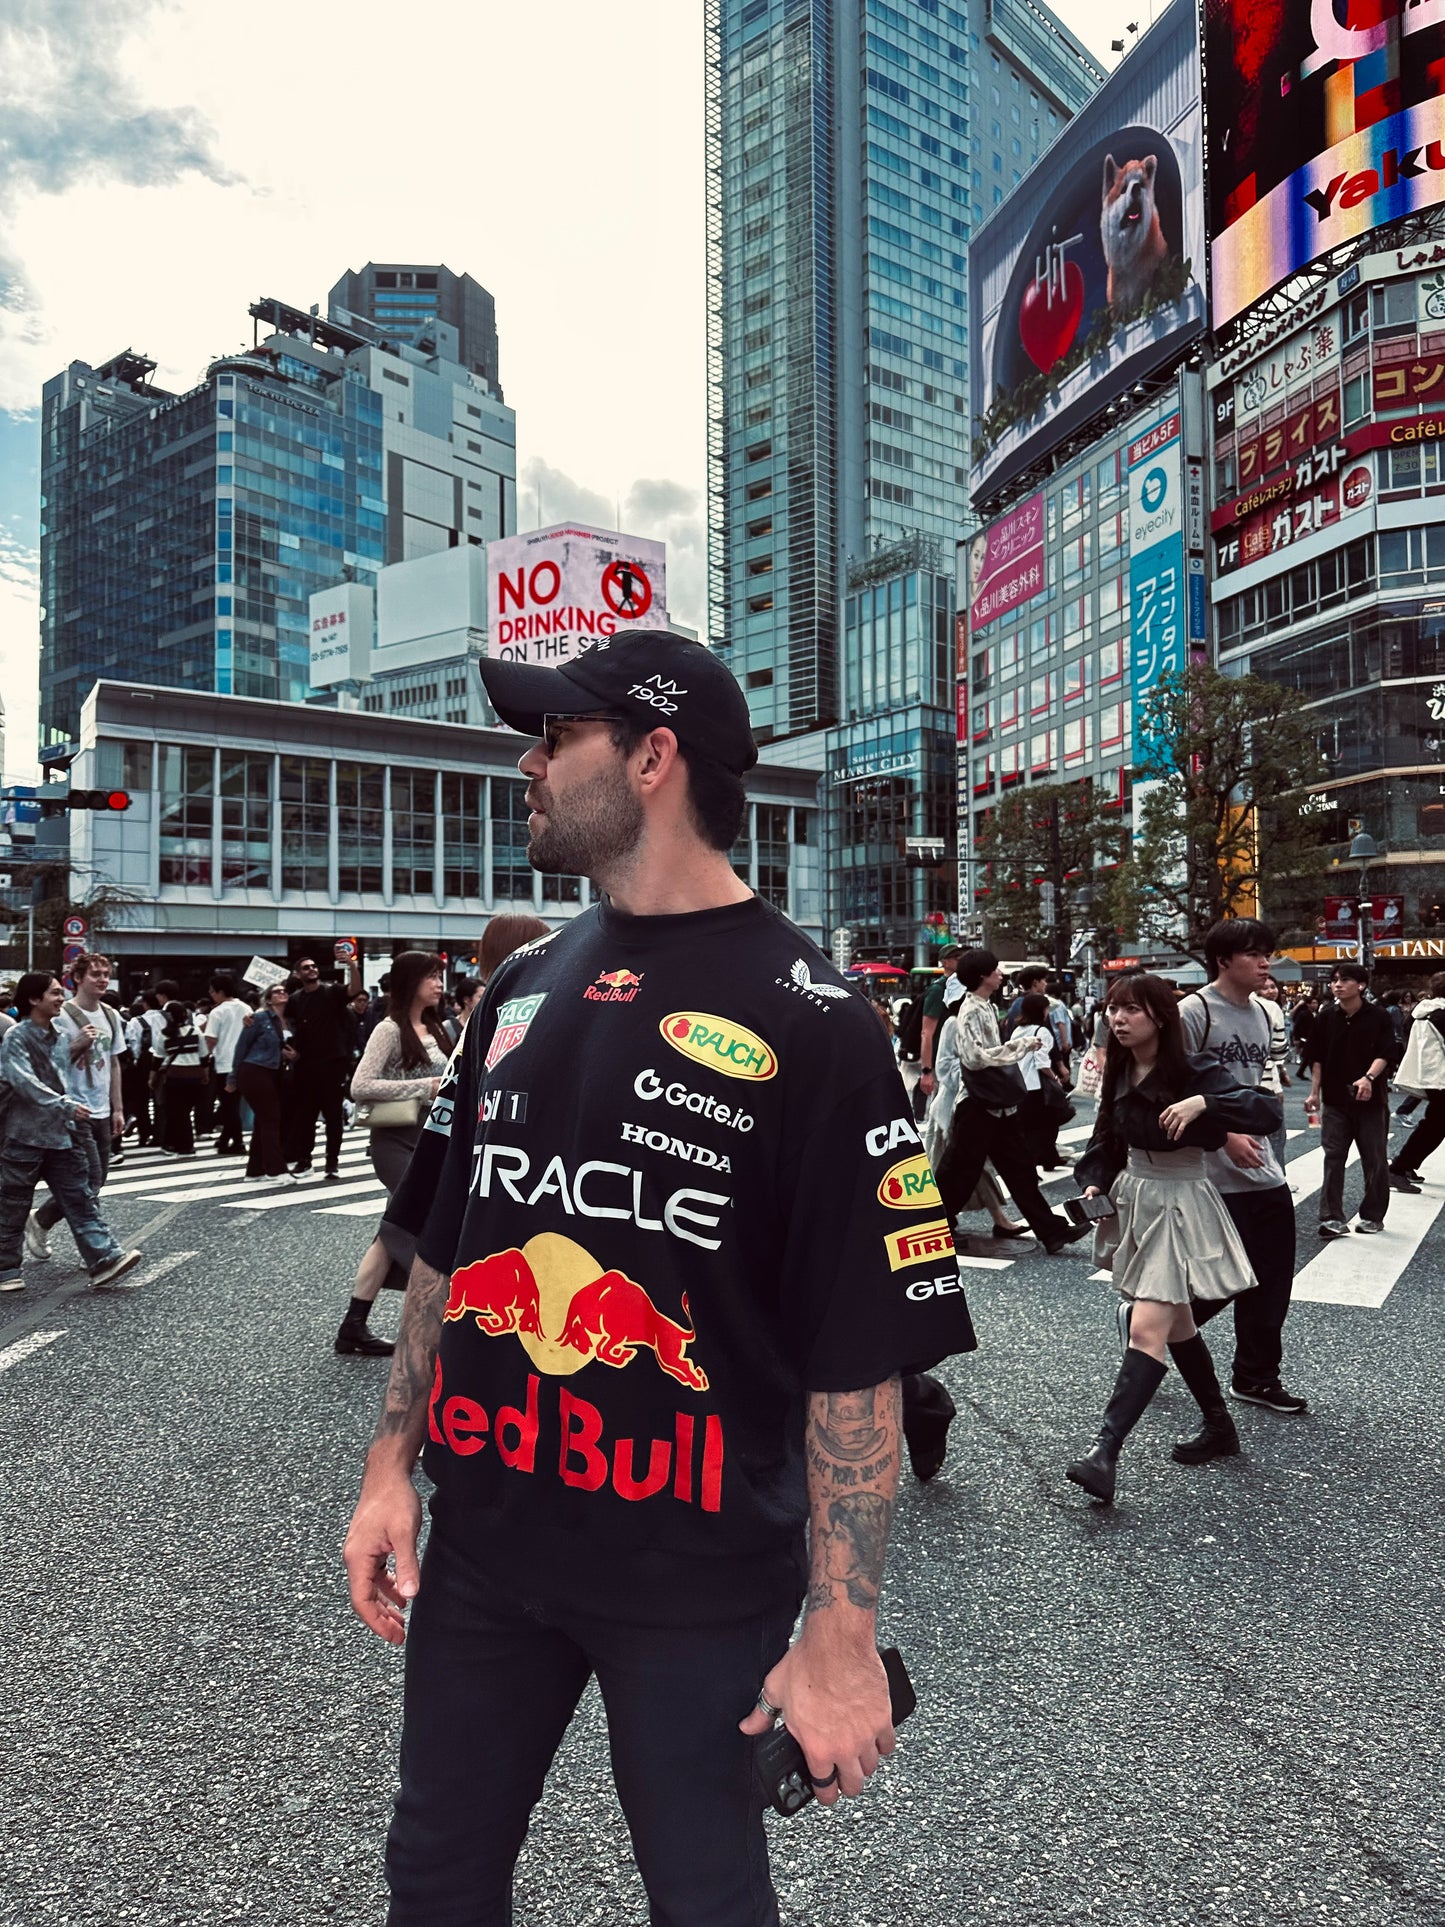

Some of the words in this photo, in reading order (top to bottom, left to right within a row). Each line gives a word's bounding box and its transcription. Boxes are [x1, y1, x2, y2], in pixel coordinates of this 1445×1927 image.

[1217, 398, 1234, 422] 9F
[1133, 419, 1175, 461] 当ビル5F
[1296, 445, 1347, 491] ガスト
[1346, 482, 1370, 500] ガスト
[1001, 506, 1040, 541] 品川スキン
[1135, 507, 1176, 540] eyecity
[1271, 494, 1334, 550] ガスト
[1001, 526, 1035, 560] クリニック
[1218, 540, 1239, 567] 7F
[499, 560, 561, 614] NO
[980, 564, 1041, 618] 品川美容外科
[499, 606, 616, 645] DRINKING
[500, 643, 527, 663] ON
[533, 635, 569, 660] THE
[626, 684, 679, 716] 1902
[833, 762, 874, 781] MARK
[880, 753, 916, 769] CITY
[852, 749, 892, 764] SHIBUYA
[774, 977, 831, 1013] CASTORE
[688, 1024, 767, 1074] RAUCH
[511, 1094, 519, 1120] 1
[665, 1082, 755, 1133] Gate.io
[620, 1122, 733, 1174] HONDA
[905, 1274, 964, 1301] GE
[558, 1386, 724, 1513] Bull
